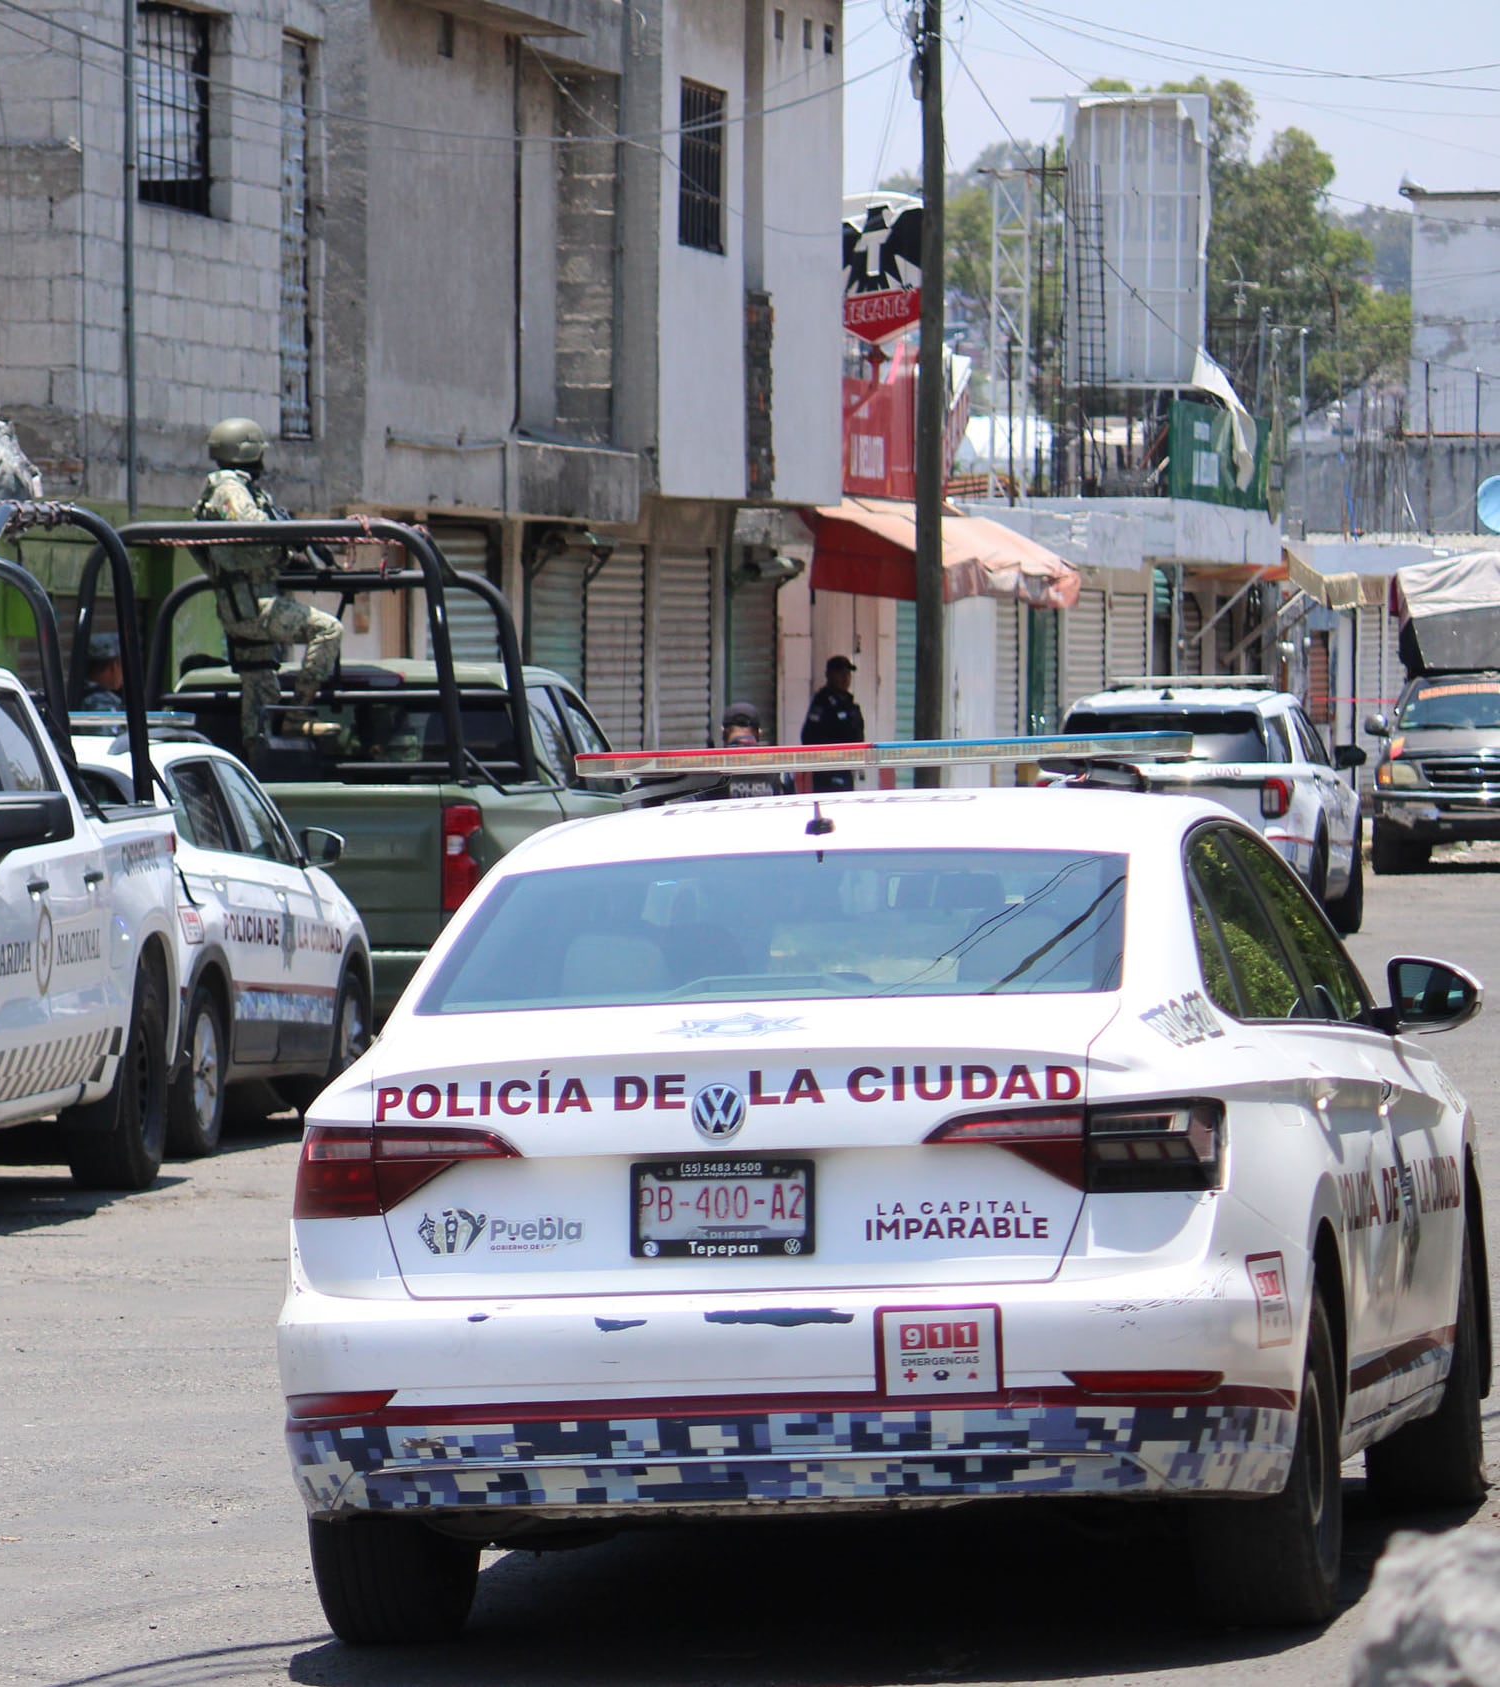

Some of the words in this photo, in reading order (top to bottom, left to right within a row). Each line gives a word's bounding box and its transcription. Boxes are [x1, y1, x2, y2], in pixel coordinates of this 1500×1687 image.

[267, 918, 279, 946] DE
[57, 928, 100, 966] NACIONAL
[376, 1070, 593, 1122] POLICÍA
[615, 1073, 687, 1113] DE
[749, 1068, 825, 1105] LA
[847, 1064, 1083, 1102] CIUDAD
[704, 1163, 731, 1173] 5483
[734, 1162, 762, 1172] 4500
[1382, 1166, 1400, 1225] DE
[877, 1202, 905, 1216] LA
[920, 1201, 1032, 1215] CAPITAL
[490, 1217, 583, 1241] Puebla
[866, 1217, 1049, 1241] IMPARABLE
[688, 1241, 759, 1257] Tepepan
[903, 1324, 973, 1348] 911
[901, 1356, 980, 1367] EMERGENCIAS
